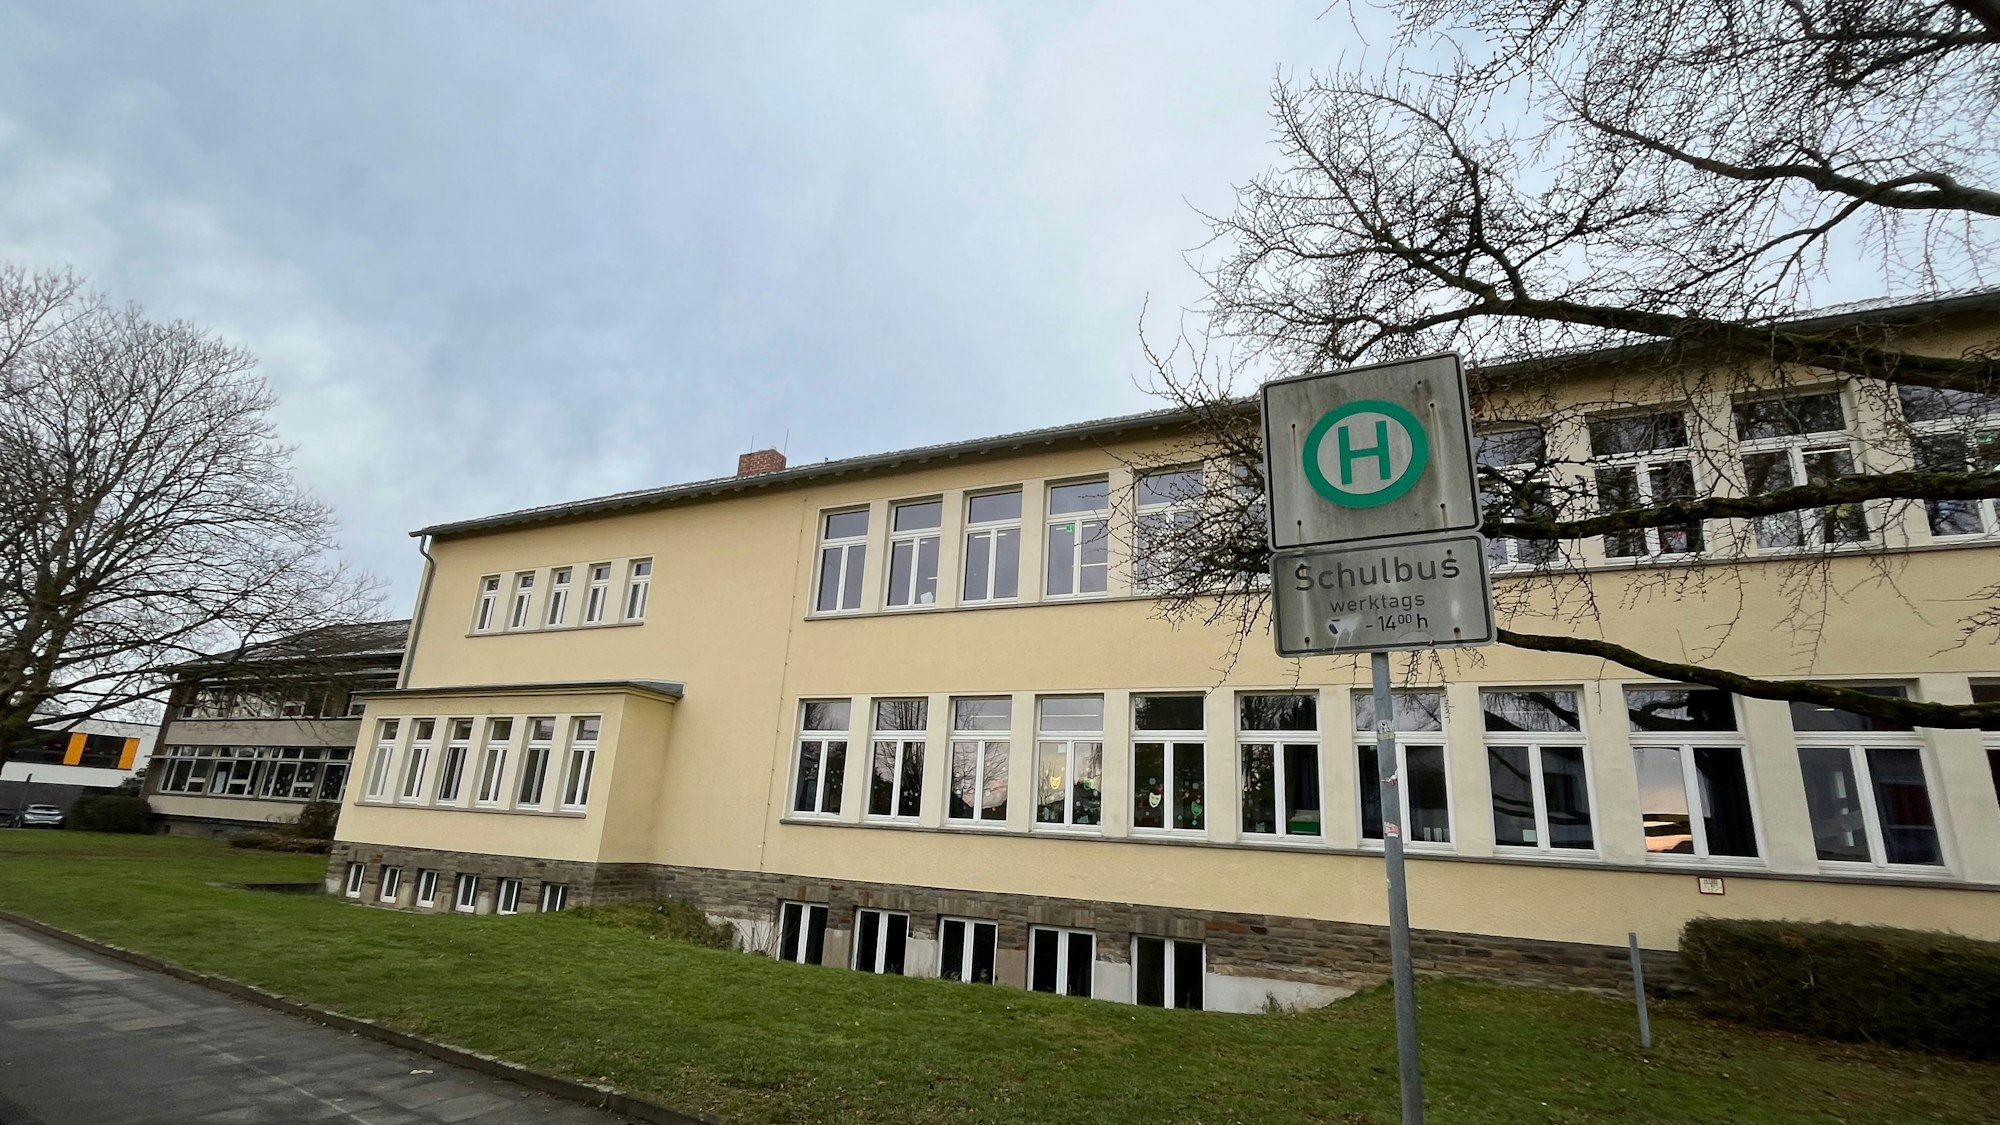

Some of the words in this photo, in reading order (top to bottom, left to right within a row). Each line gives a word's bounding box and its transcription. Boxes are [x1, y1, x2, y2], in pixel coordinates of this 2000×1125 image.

[1338, 420, 1391, 486] H
[1294, 556, 1460, 591] Schulbus
[1330, 594, 1425, 613] werktags
